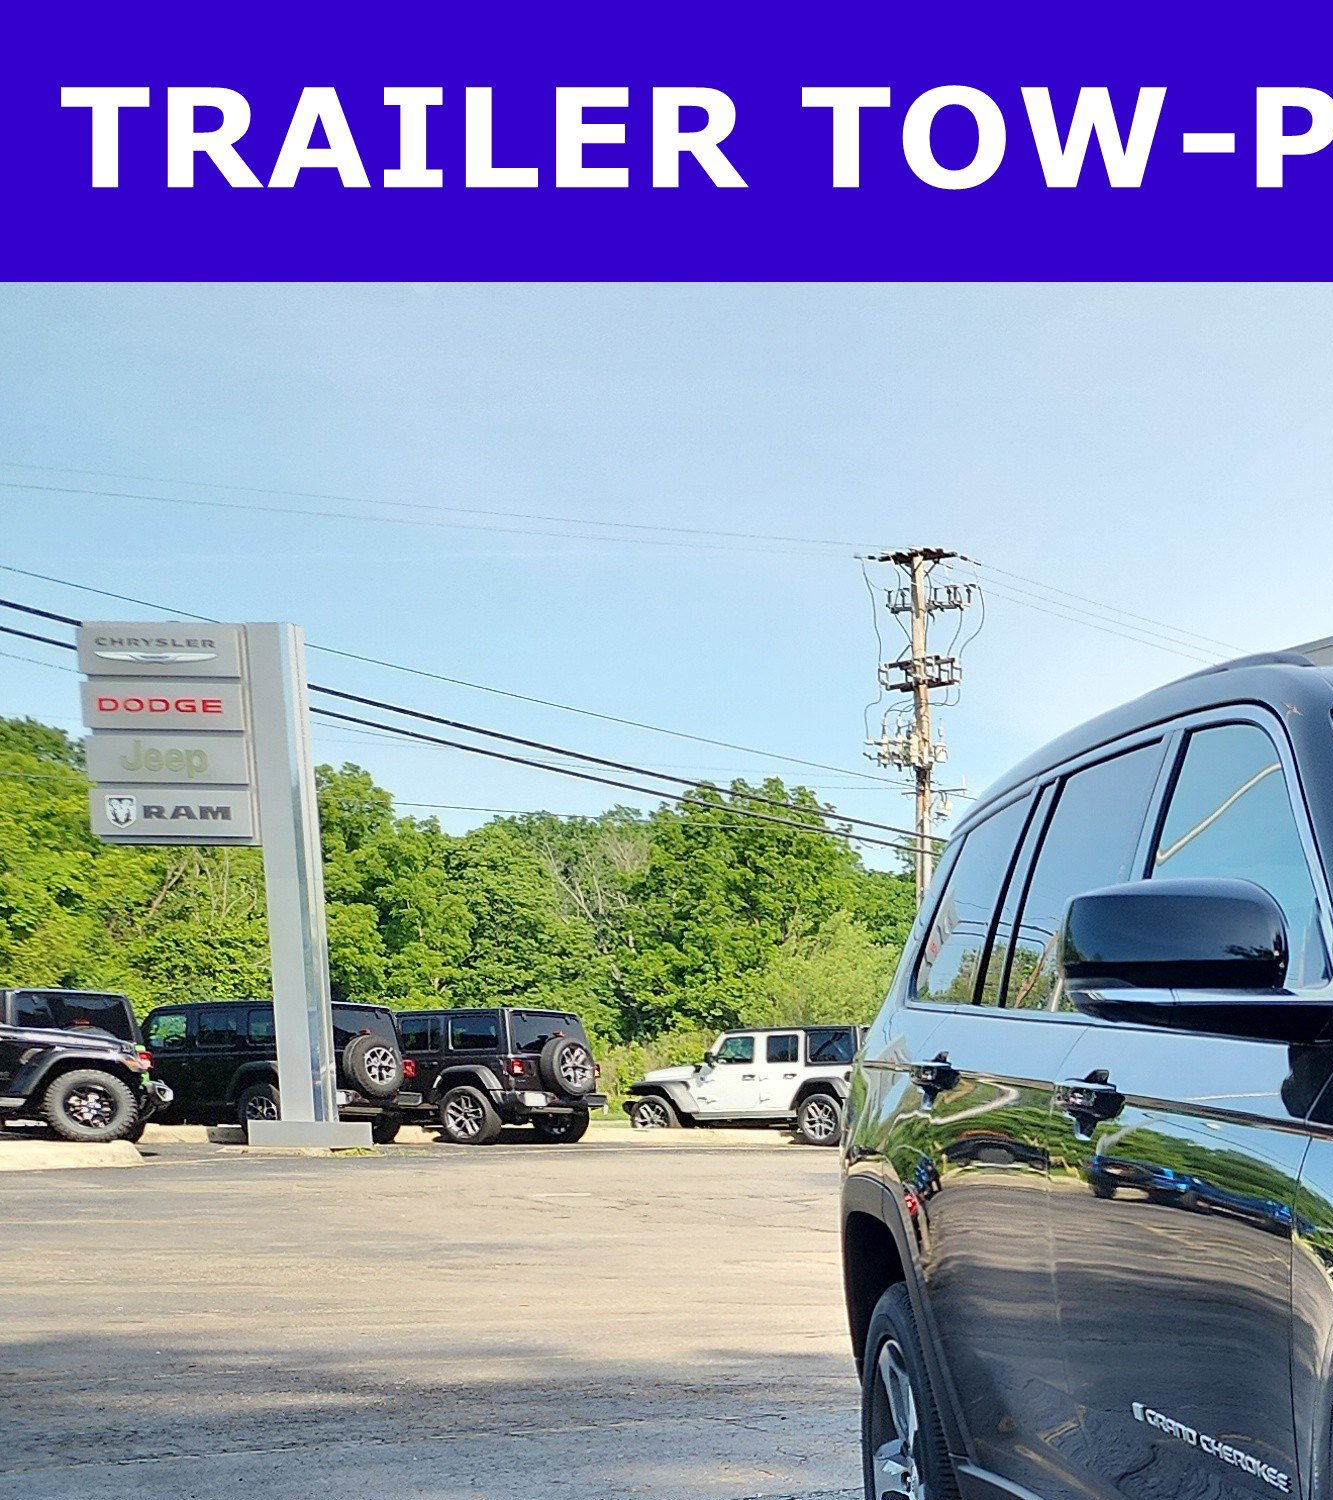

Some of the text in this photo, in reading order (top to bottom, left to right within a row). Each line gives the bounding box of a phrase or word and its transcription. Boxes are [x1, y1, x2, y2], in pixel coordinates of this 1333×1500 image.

[95, 637, 216, 648] CHRYSLER
[97, 697, 224, 714] DODGE
[120, 740, 211, 778] Jeep
[143, 804, 231, 821] RAM
[1145, 1409, 1292, 1494] GRAND CHEROKEE
